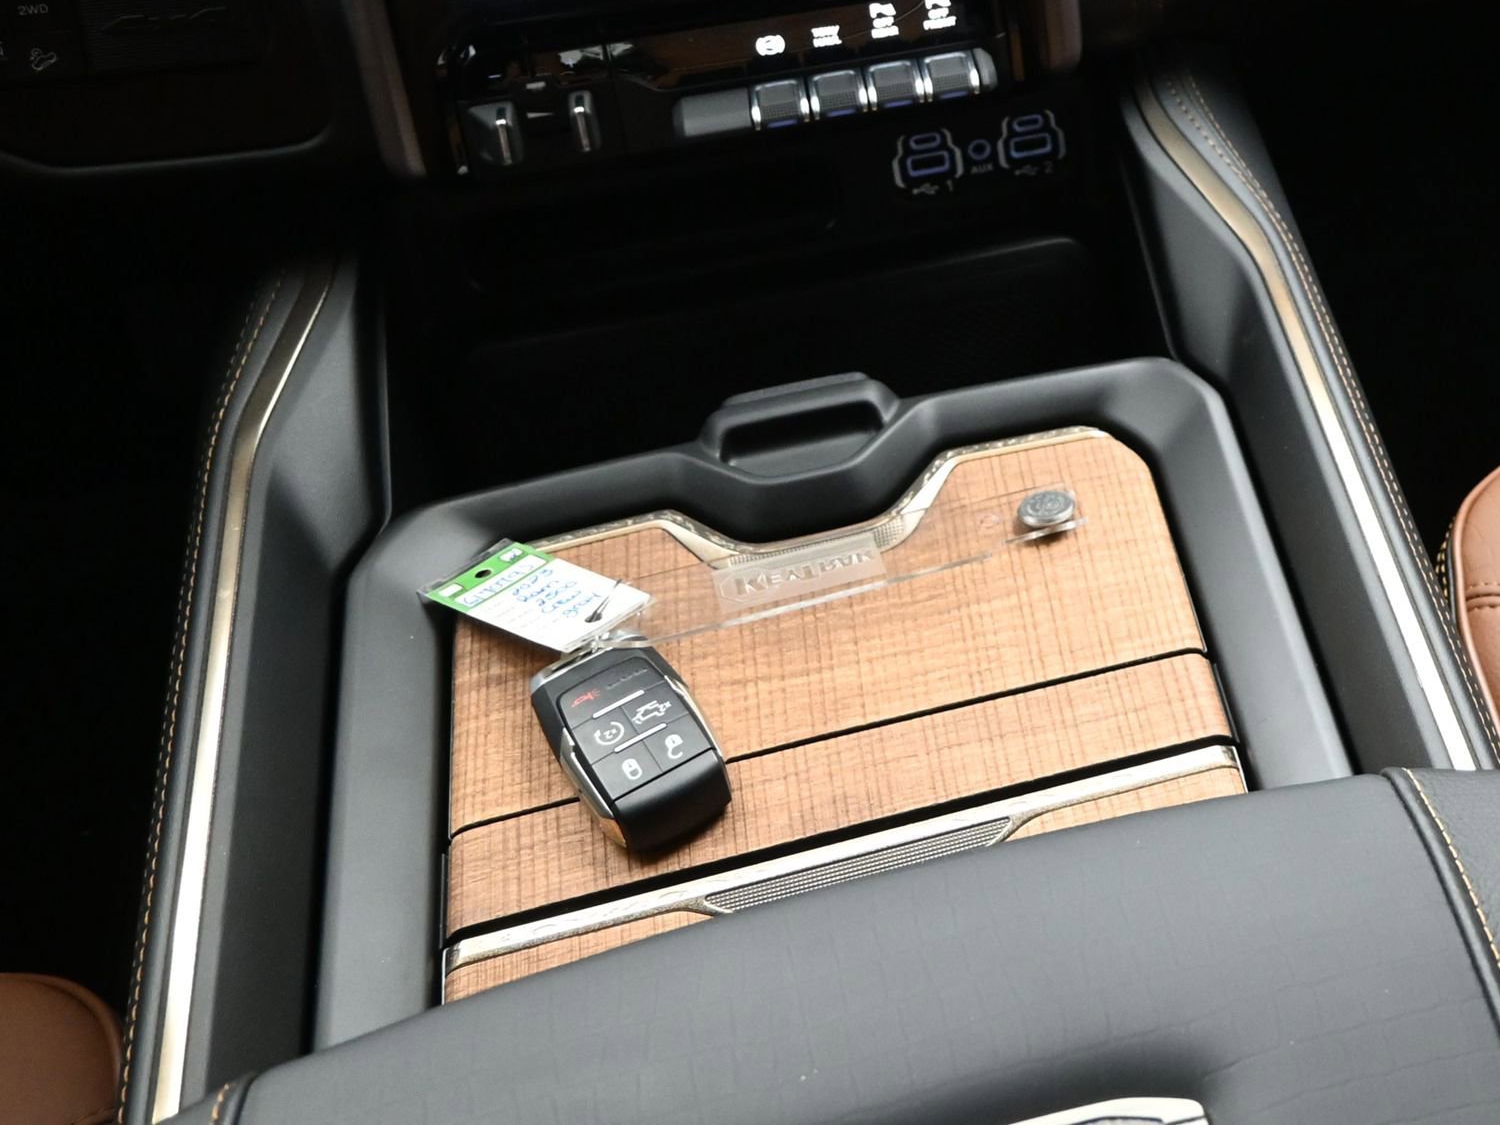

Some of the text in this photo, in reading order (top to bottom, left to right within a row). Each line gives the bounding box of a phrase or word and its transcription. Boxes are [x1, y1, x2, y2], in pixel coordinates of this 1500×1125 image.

[16, 3, 49, 17] 2WD
[969, 162, 995, 175] AUX
[1043, 160, 1055, 175] 2
